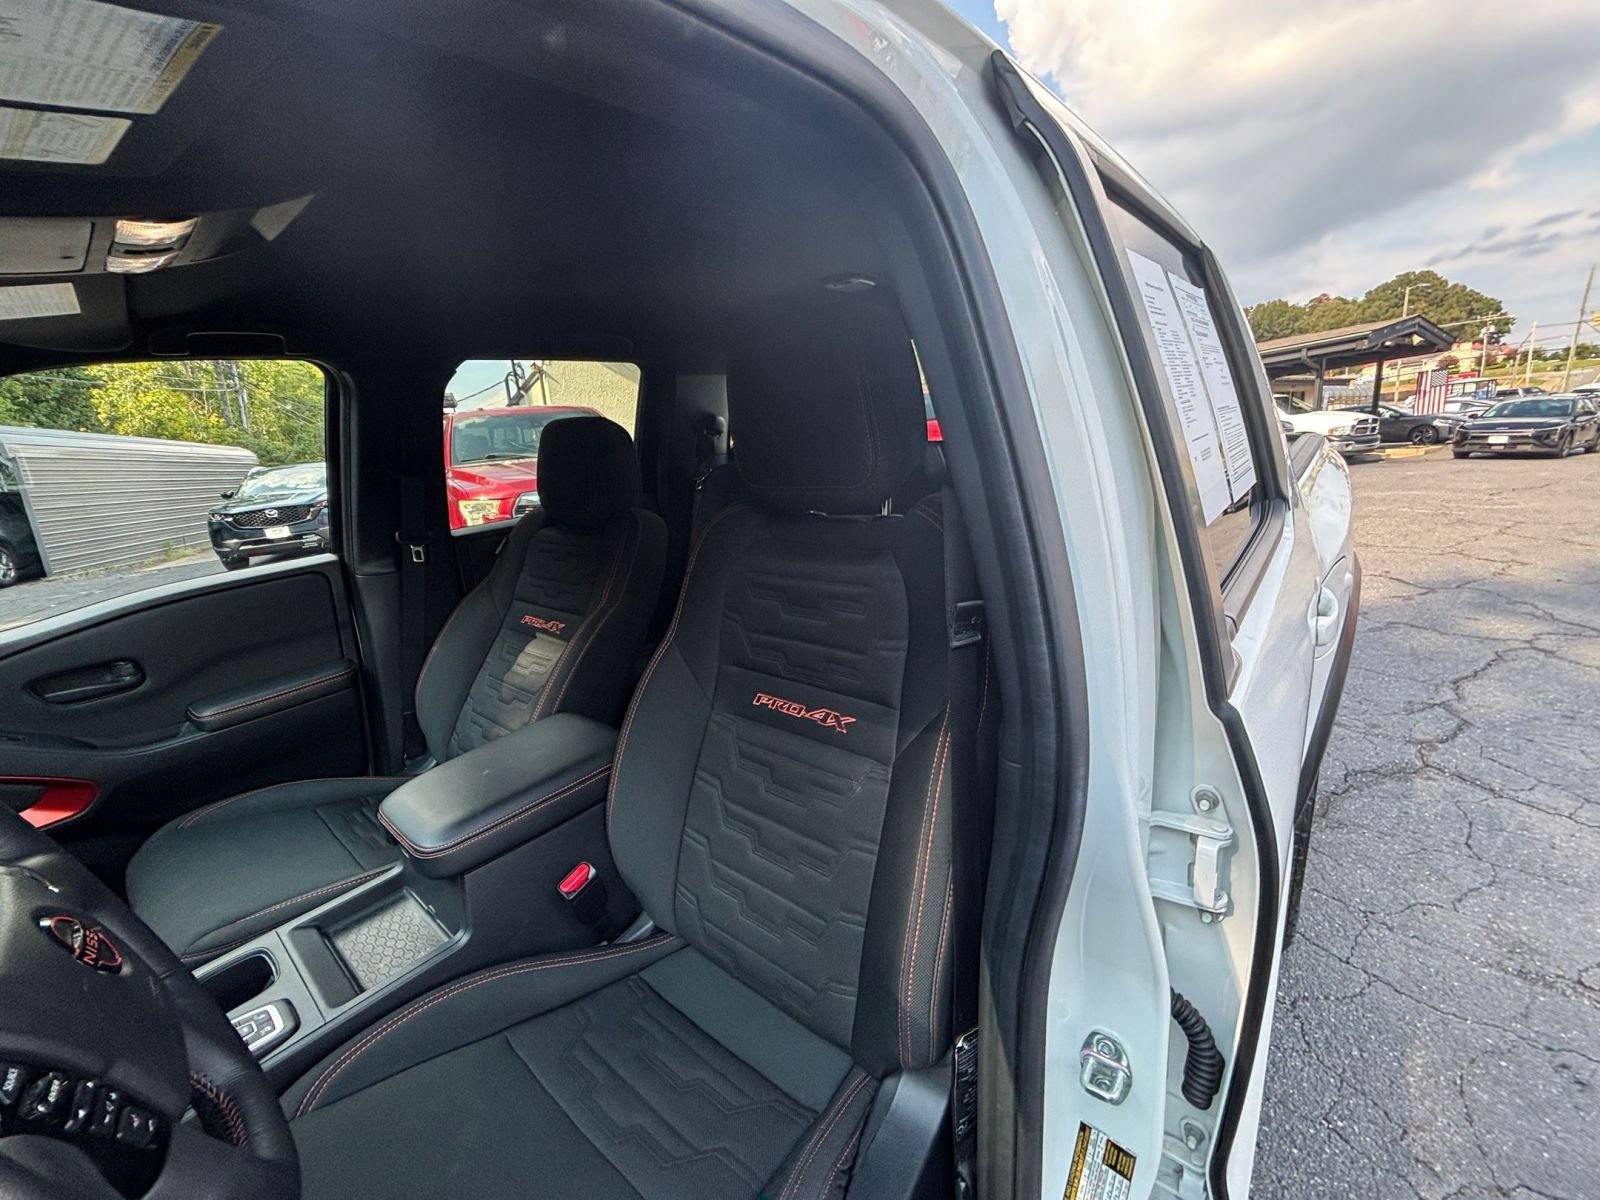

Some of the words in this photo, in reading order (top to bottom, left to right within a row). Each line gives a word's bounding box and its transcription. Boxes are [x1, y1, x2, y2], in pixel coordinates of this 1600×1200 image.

[82, 928, 99, 964] NISS
[2, 1067, 19, 1091] SOURCE
[47, 1079, 61, 1103] ENTER
